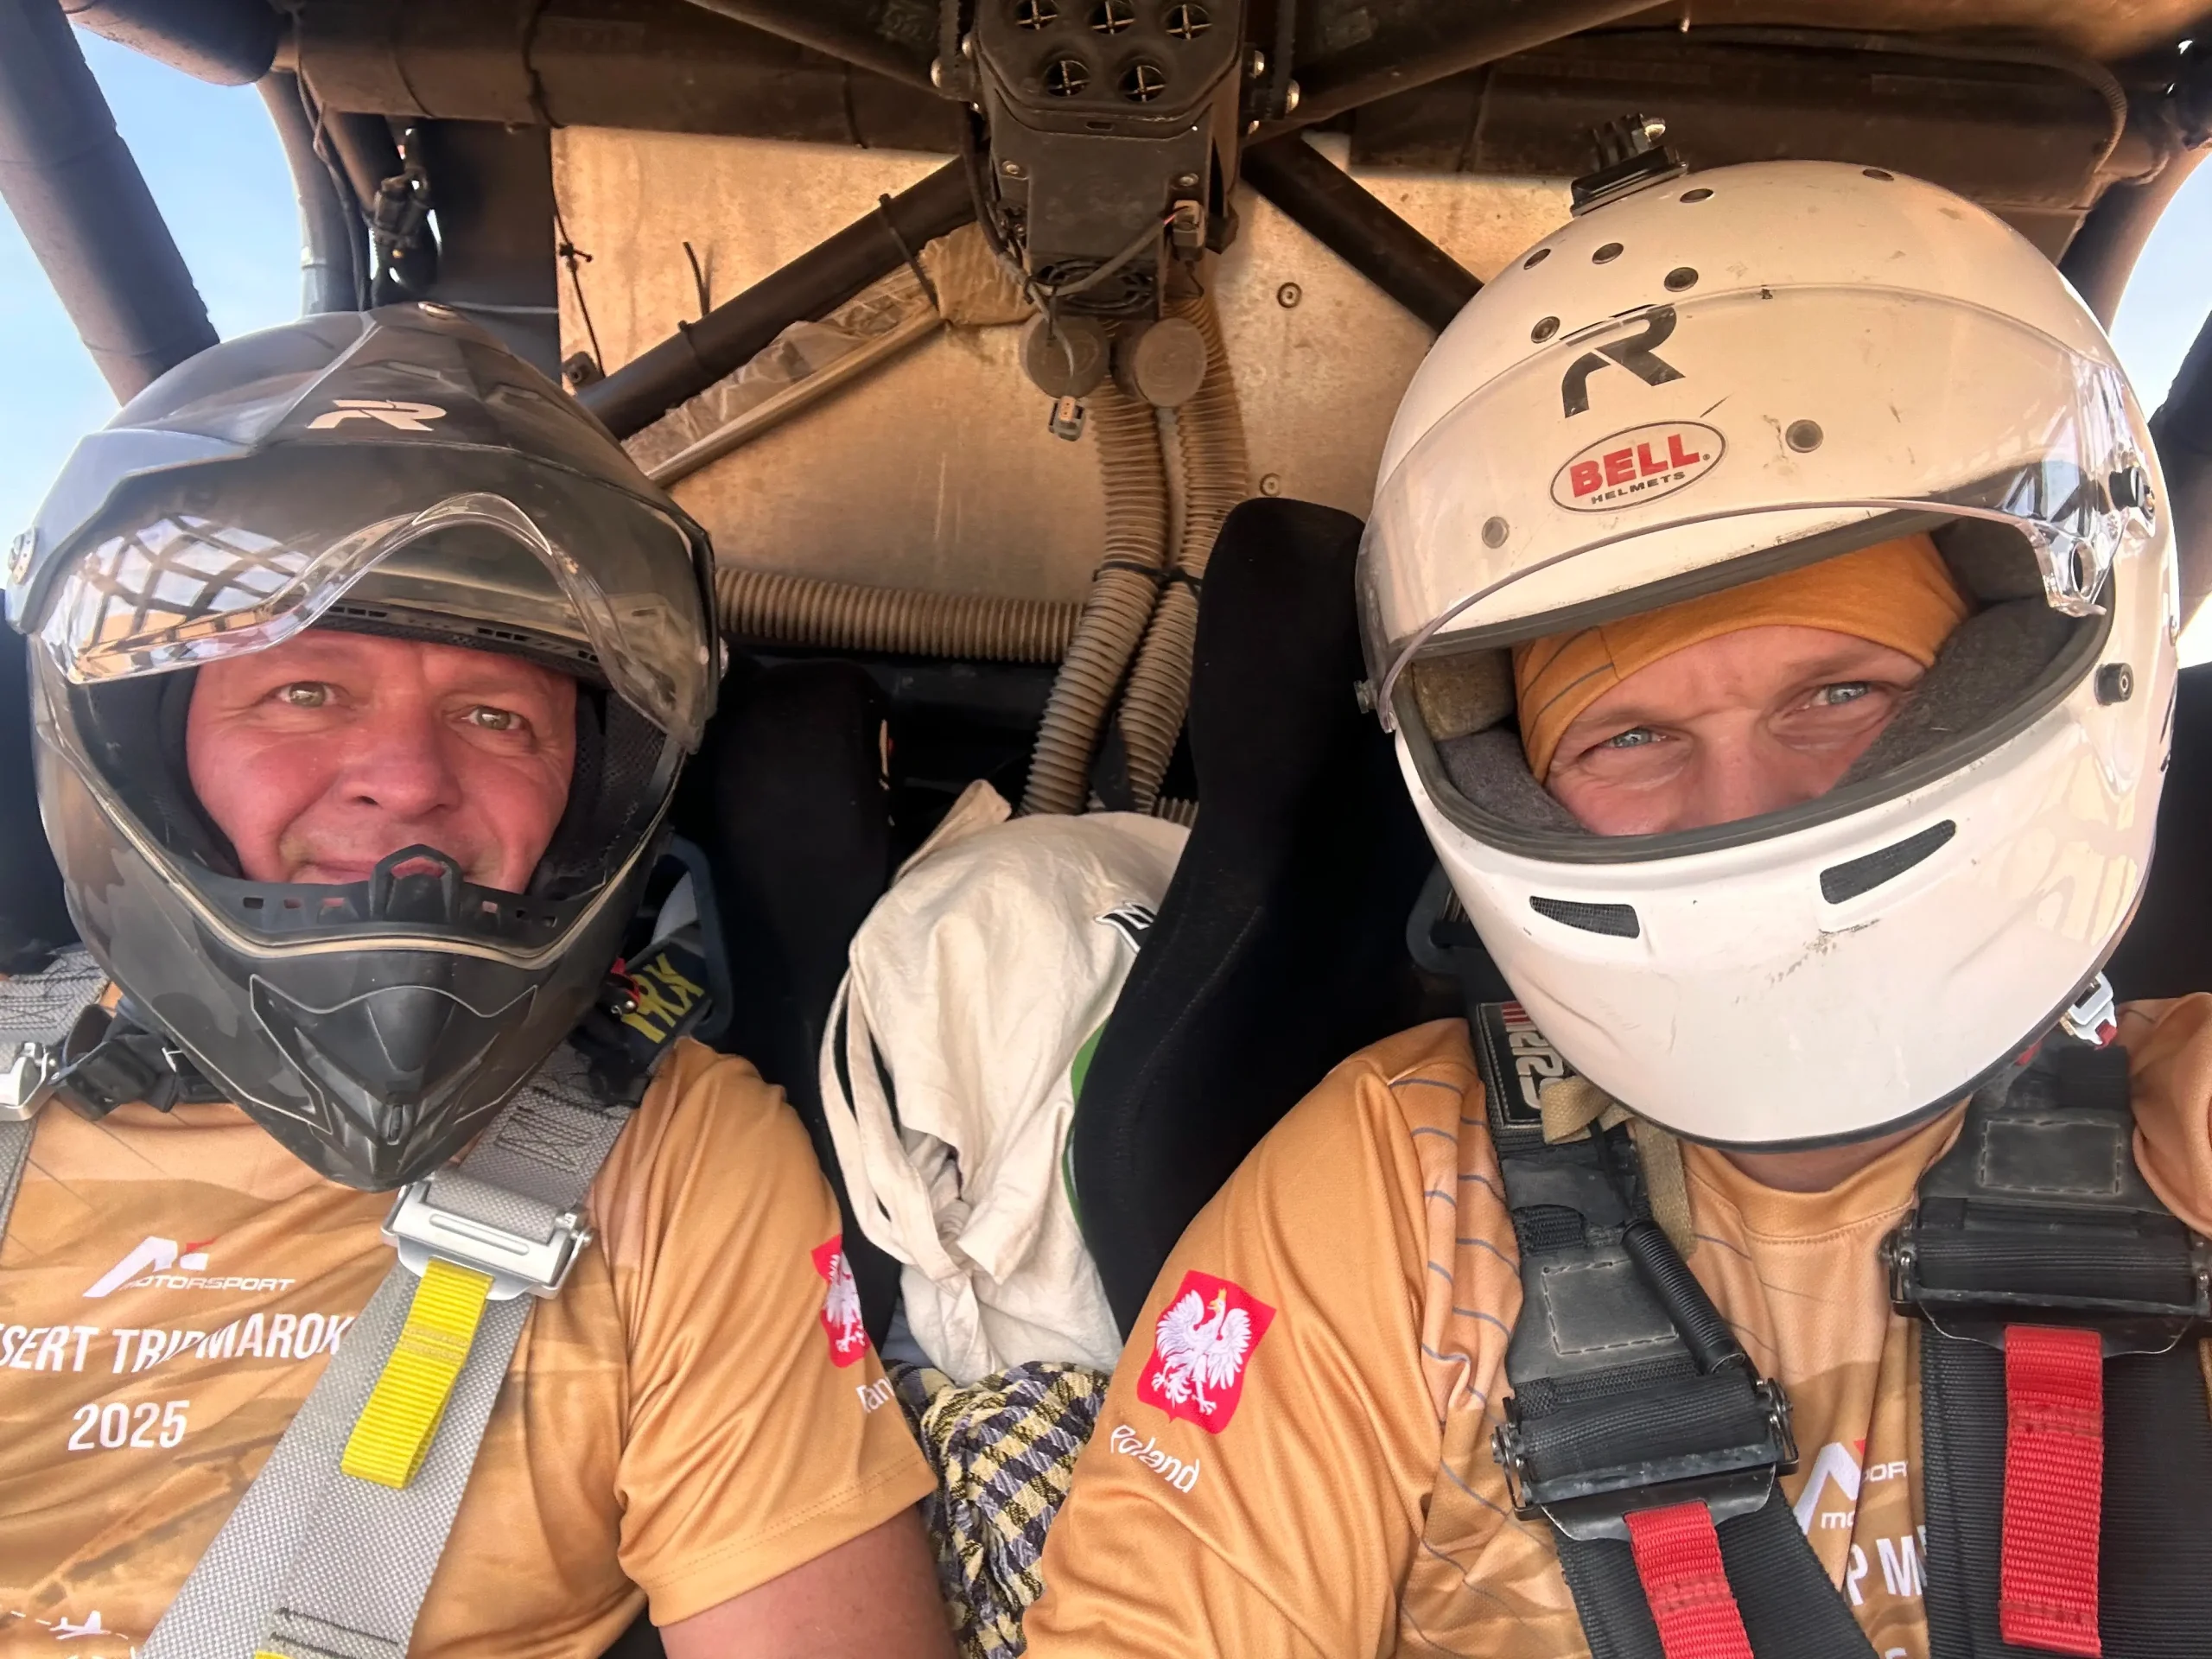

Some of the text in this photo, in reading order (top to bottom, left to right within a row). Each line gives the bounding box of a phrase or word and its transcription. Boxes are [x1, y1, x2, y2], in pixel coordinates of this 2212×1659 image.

[1570, 434, 1700, 498] BELL
[1591, 471, 1686, 504] HELMETS
[0, 1313, 355, 1374] SERT TRIP MAROK
[67, 1400, 190, 1452] 2025
[1110, 1424, 1200, 1493] Poland
